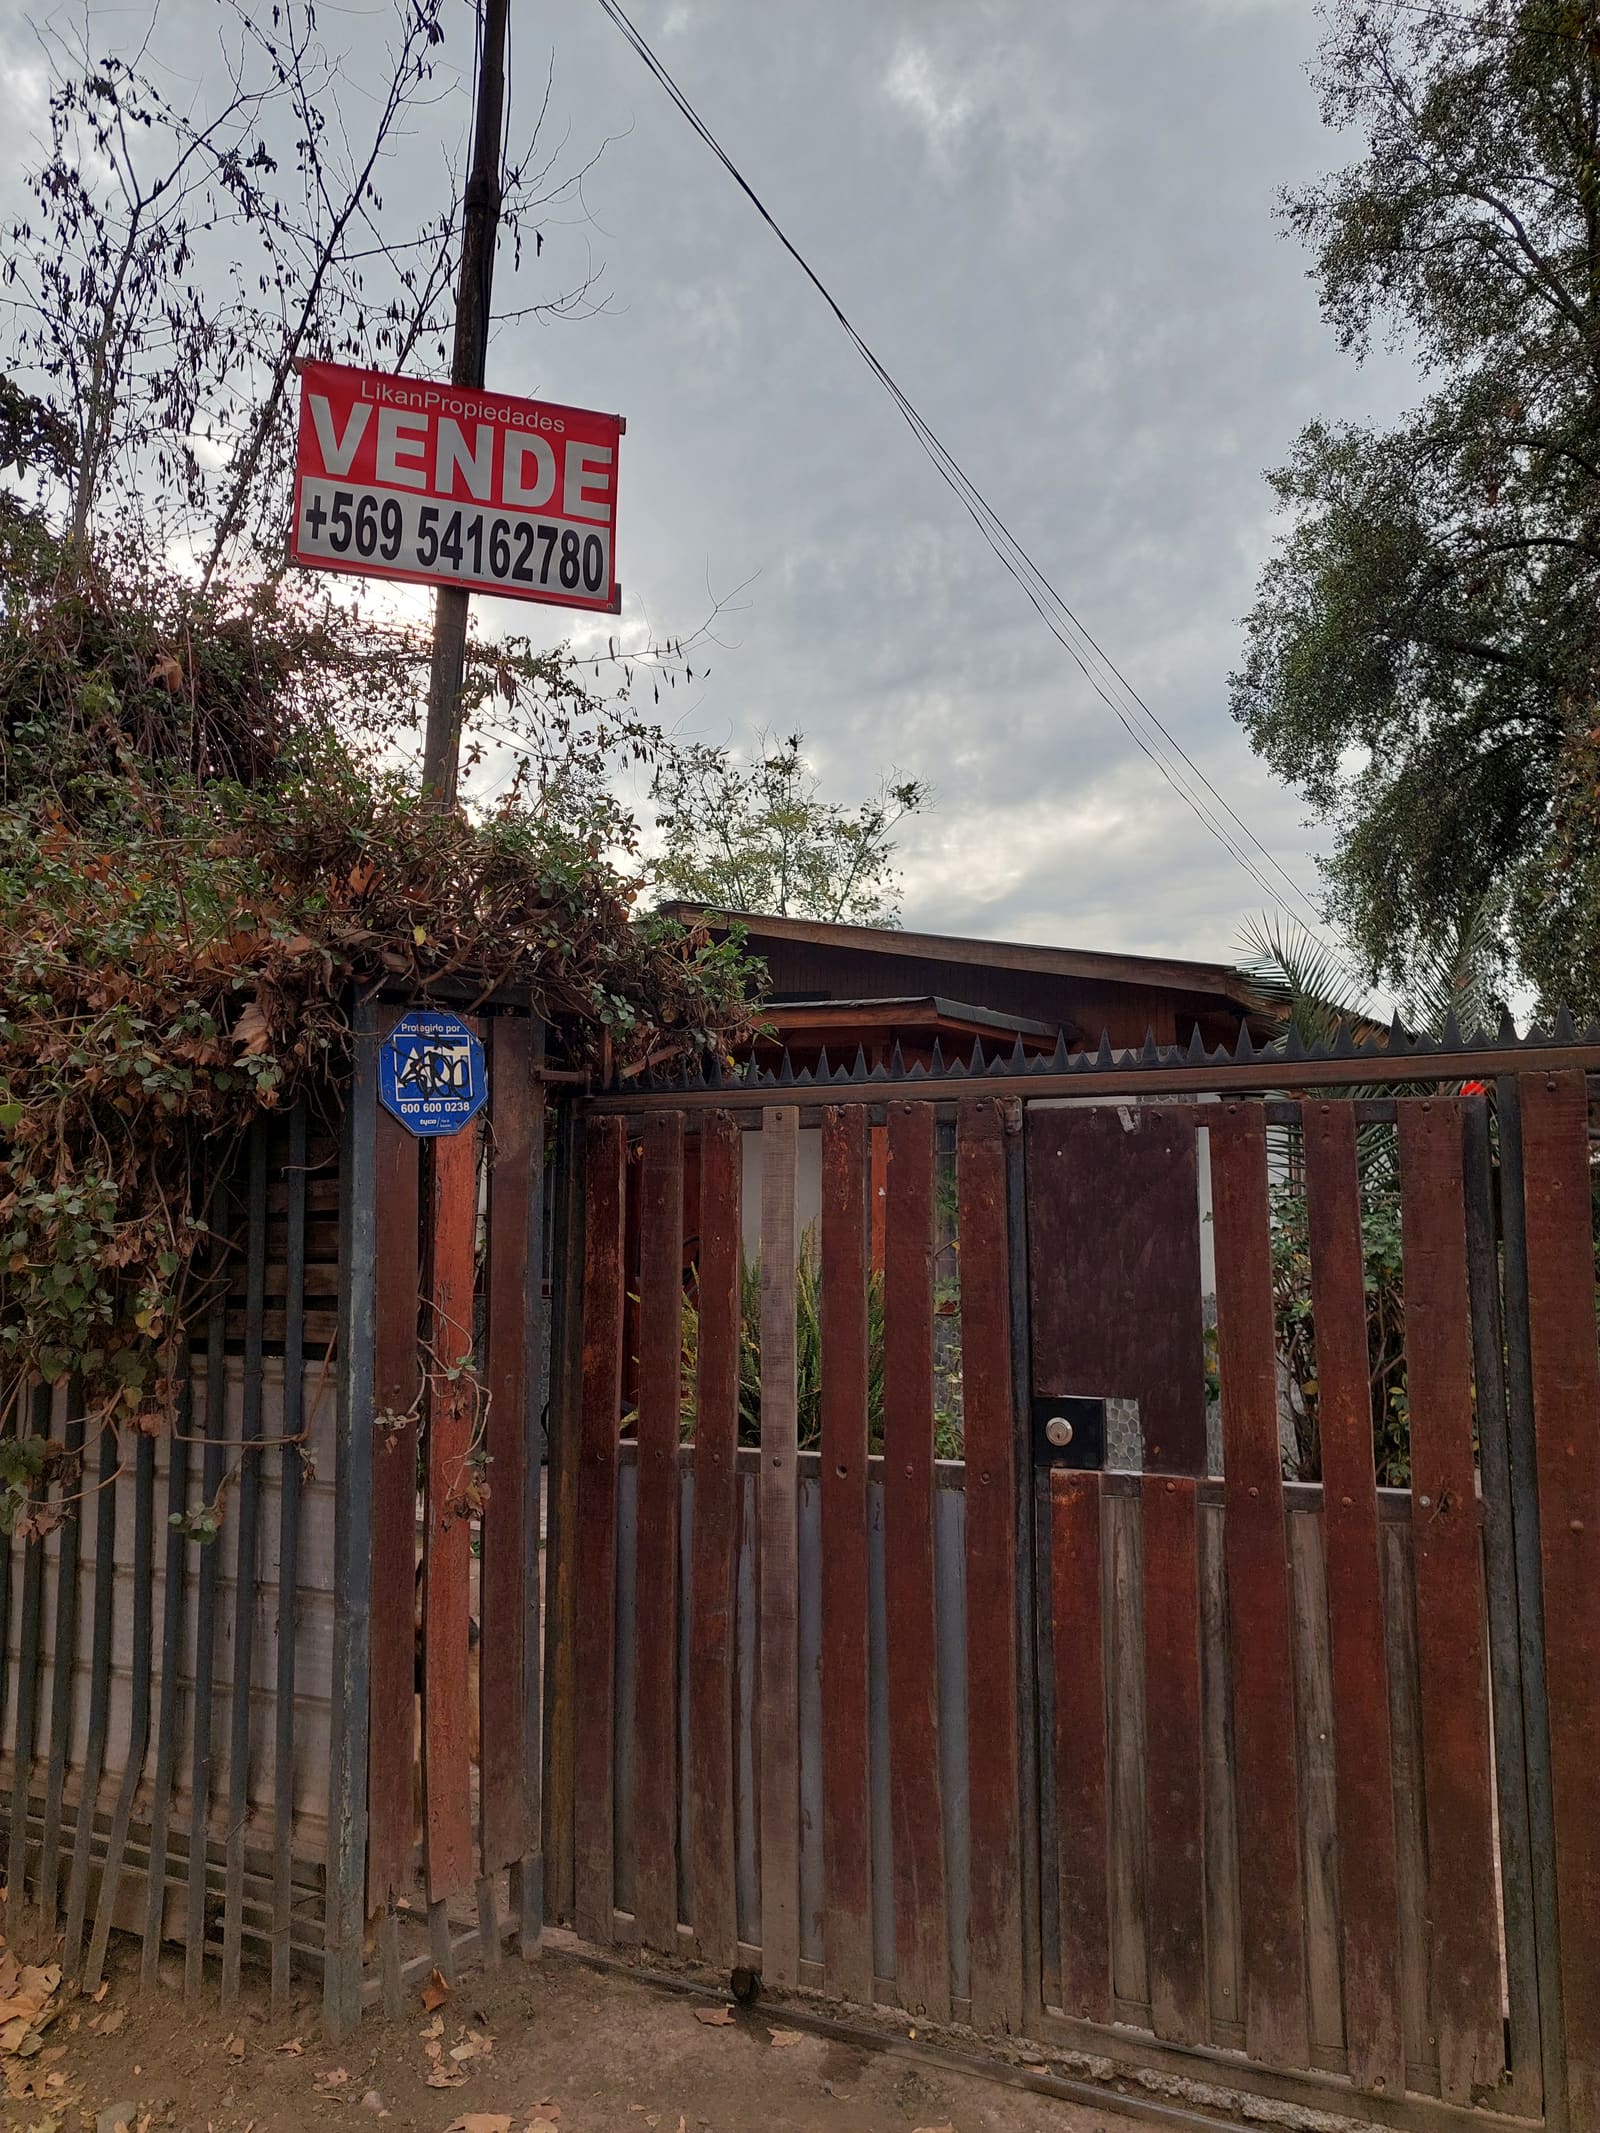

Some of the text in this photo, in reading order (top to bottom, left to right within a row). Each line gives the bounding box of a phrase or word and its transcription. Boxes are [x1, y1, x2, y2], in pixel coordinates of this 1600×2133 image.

[361, 380, 566, 433] LikanPropiedades
[308, 393, 613, 522] VENDE
[305, 490, 604, 592] +569 54162780
[401, 1023, 461, 1034] Protegido por
[401, 1101, 470, 1114] 600 600 0238
